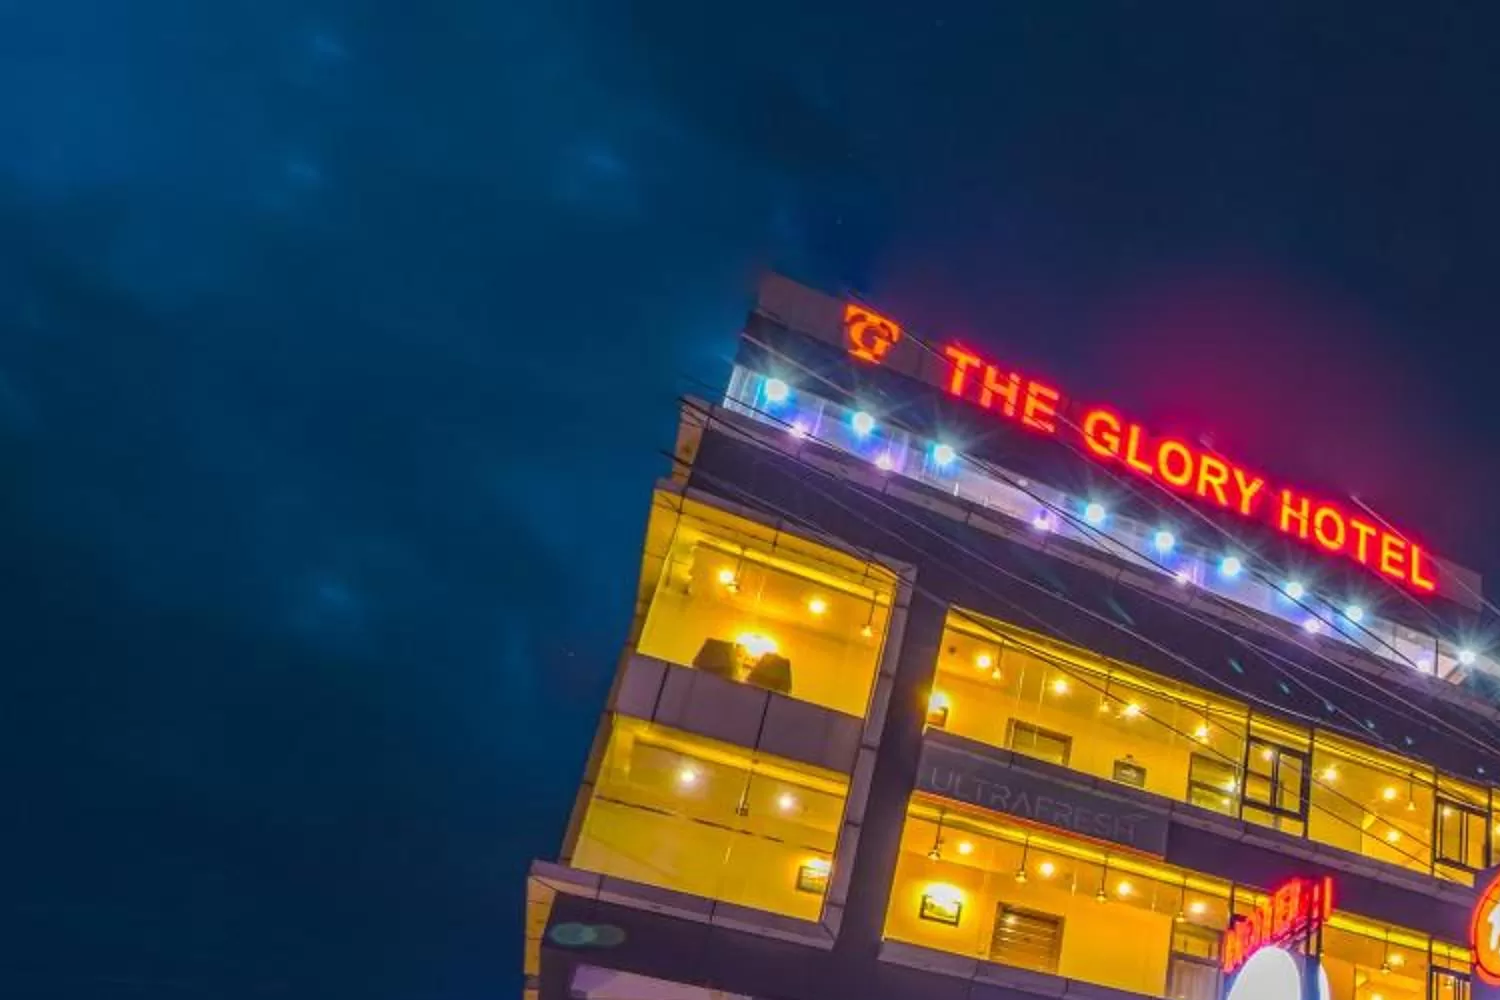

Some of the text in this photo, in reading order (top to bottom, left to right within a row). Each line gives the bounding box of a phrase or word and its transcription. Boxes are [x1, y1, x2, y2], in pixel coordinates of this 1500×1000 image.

[944, 345, 1437, 592] THE GLORY HOTEL
